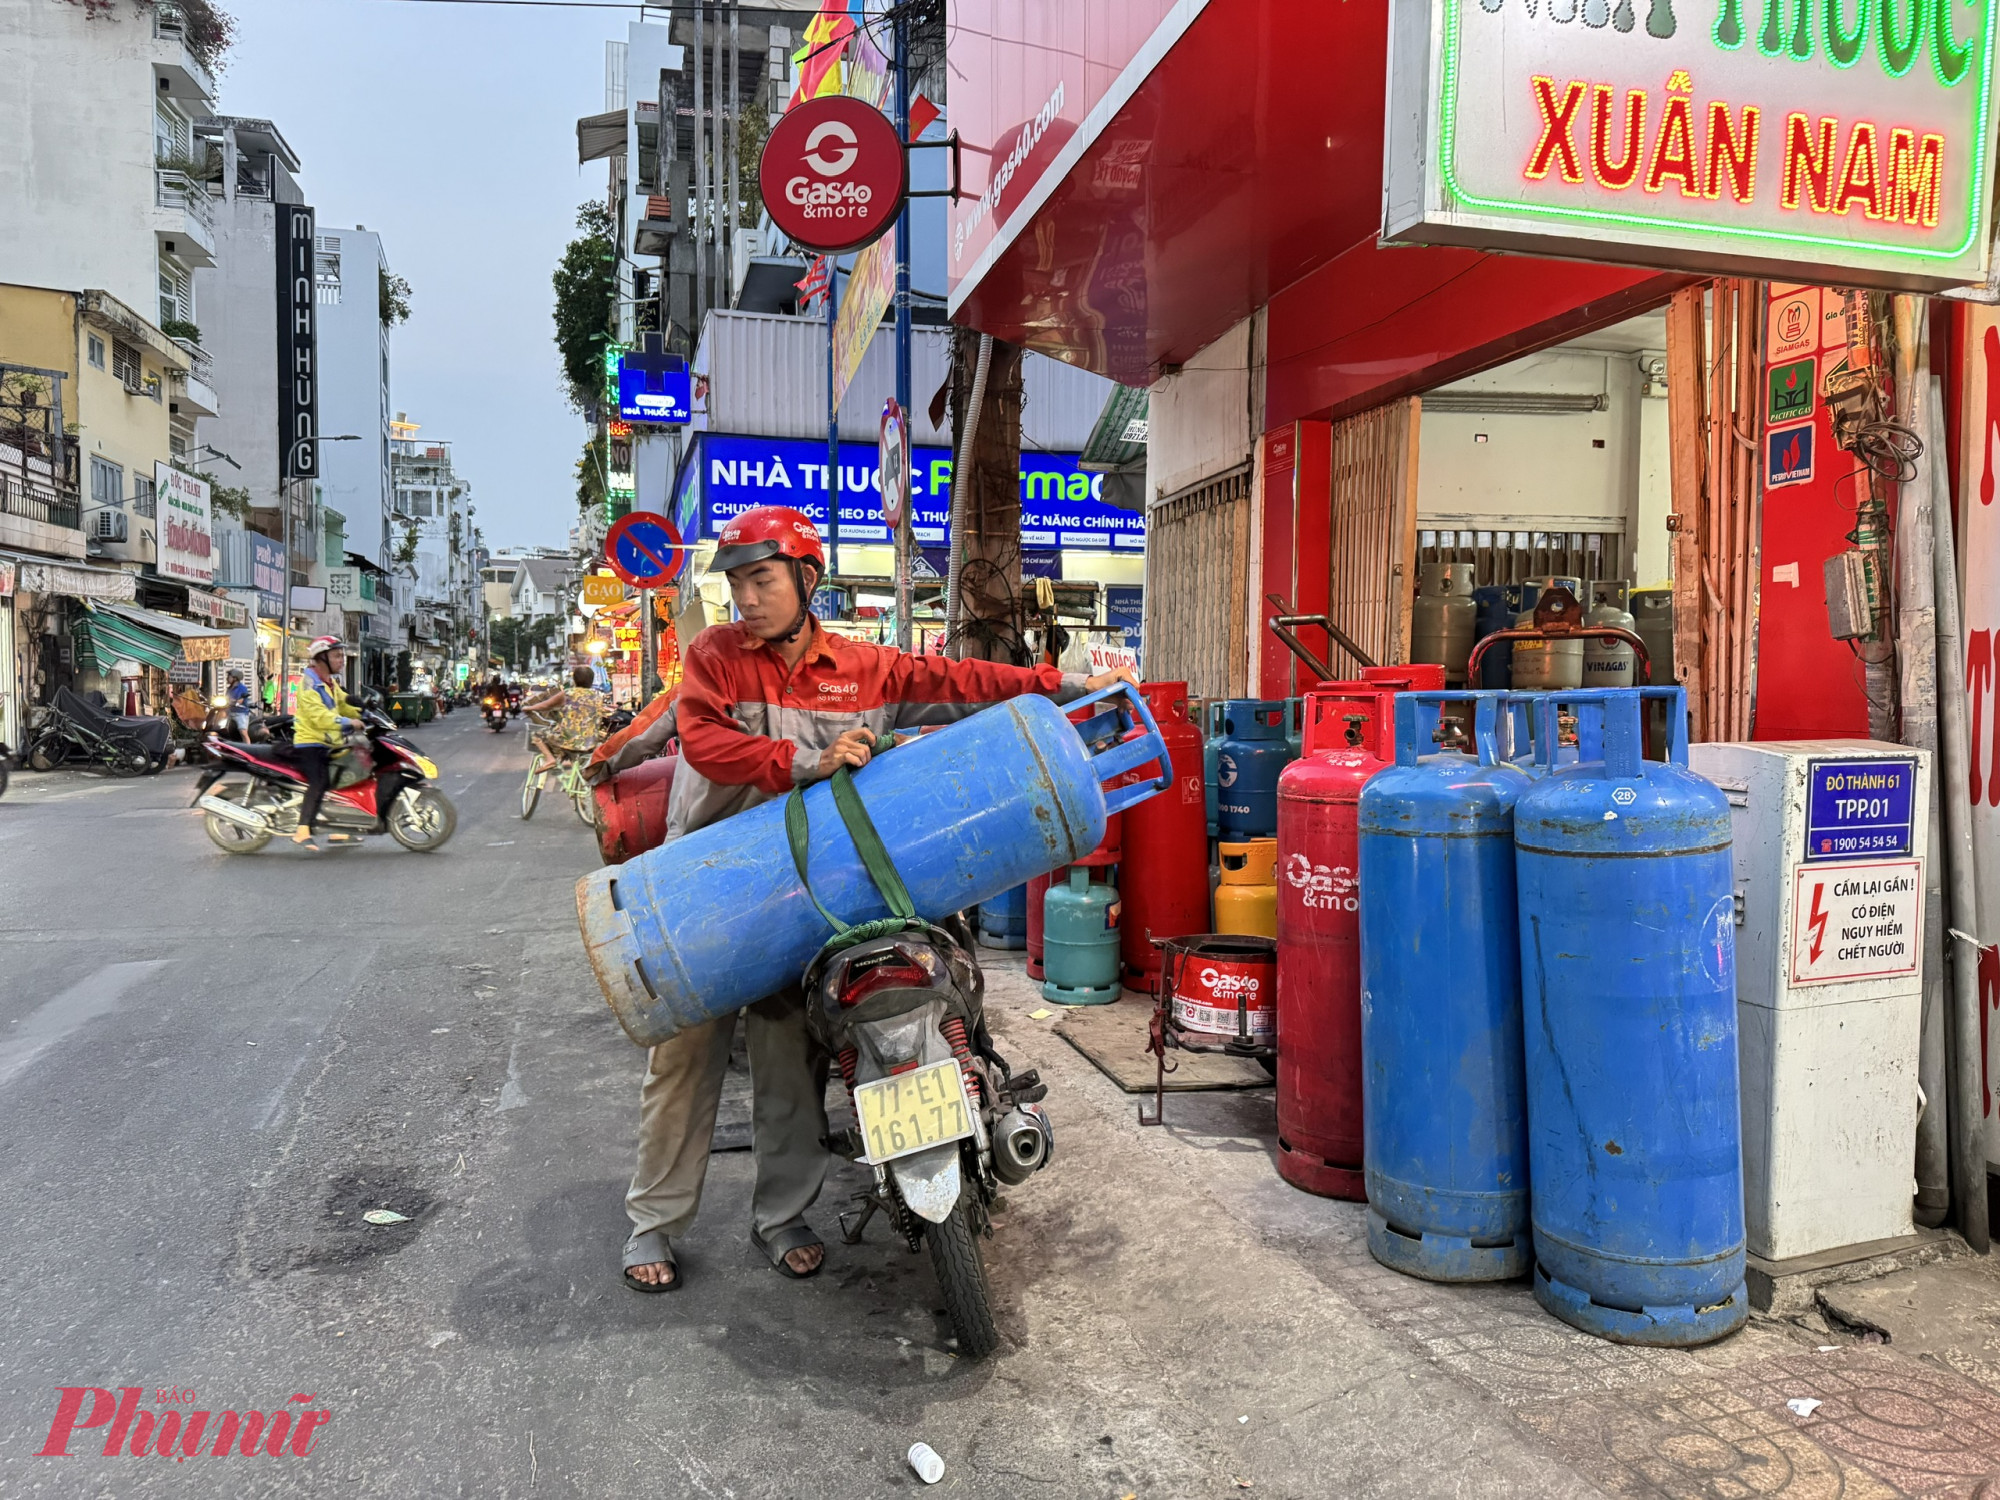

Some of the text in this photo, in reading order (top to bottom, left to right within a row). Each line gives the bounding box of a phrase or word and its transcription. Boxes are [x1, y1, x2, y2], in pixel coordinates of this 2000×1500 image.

[1523, 69, 1945, 227] XUÂN NAM
[965, 80, 1066, 240] www.gas40.com
[1825, 310, 1839, 322] Gia
[292, 213, 312, 470] MINH HÙNG
[1776, 338, 1810, 355] SIAMGAS
[1770, 405, 1812, 422] PACIFIC GAS
[711, 455, 793, 489] NHÀ
[1771, 467, 1810, 483] PETROVIETNAM
[1042, 513, 1081, 527] NĂNG
[1083, 515, 1124, 529] CHÍNH
[586, 582, 621, 600] GẠO
[1586, 660, 1627, 672] VINAGAS
[1826, 773, 1900, 792] ĐÔ THÀNH 61
[1616, 790, 1631, 800] 28
[1230, 805, 1250, 814] 1740
[1835, 798, 1890, 820] TPP.01
[1834, 835, 1898, 851] 1900 54 54 54
[1834, 879, 1861, 897] CẤM
[1863, 879, 1881, 898] LẠI
[1883, 876, 1908, 892] GẦN
[1851, 902, 1895, 921] CÓ ĐIỆN
[1842, 919, 1902, 941] NGUY HIỂM
[1838, 941, 1905, 960] CHẾT NGƯỜI
[854, 954, 894, 968] HONDA
[872, 1068, 947, 1118] 77-E1
[871, 1100, 964, 1157] 161.77
